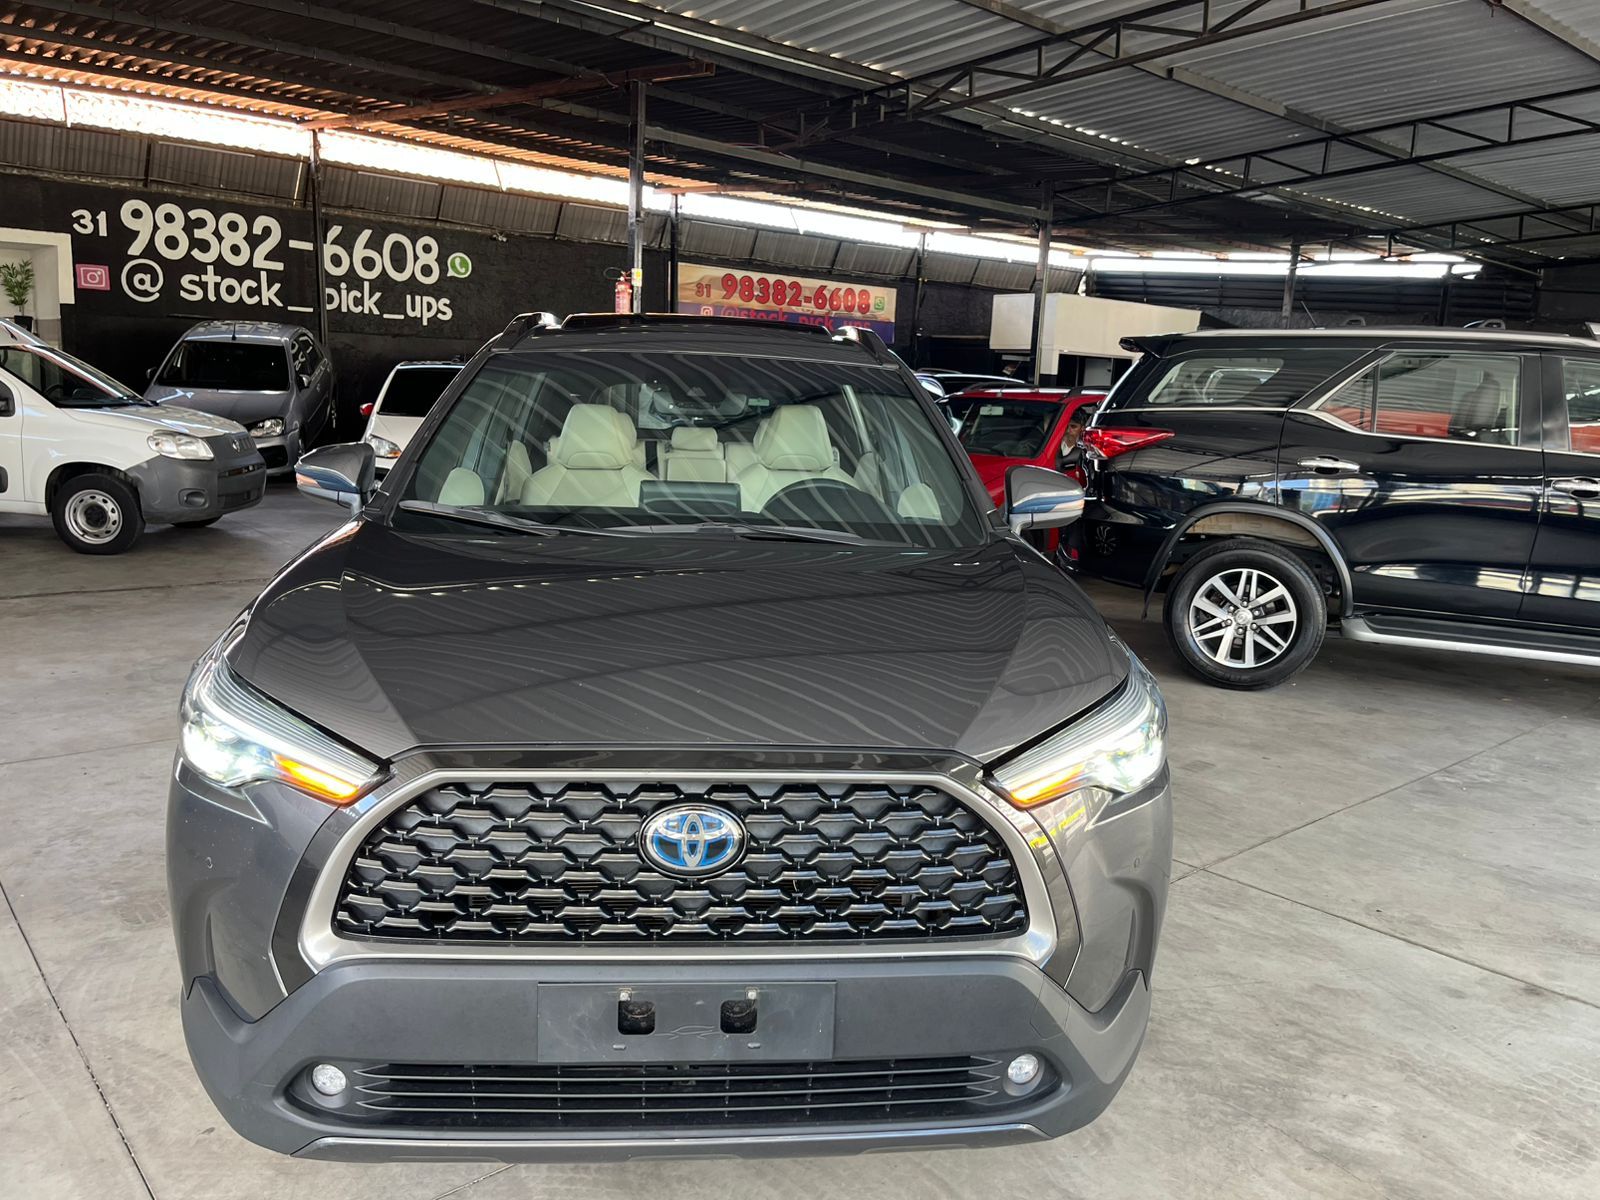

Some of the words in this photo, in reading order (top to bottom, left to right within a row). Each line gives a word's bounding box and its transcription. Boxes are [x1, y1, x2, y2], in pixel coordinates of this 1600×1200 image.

[71, 208, 108, 237] 31
[119, 198, 440, 285] 98382-6608
[695, 282, 712, 298] 31
[721, 272, 871, 315] 98382-6608
